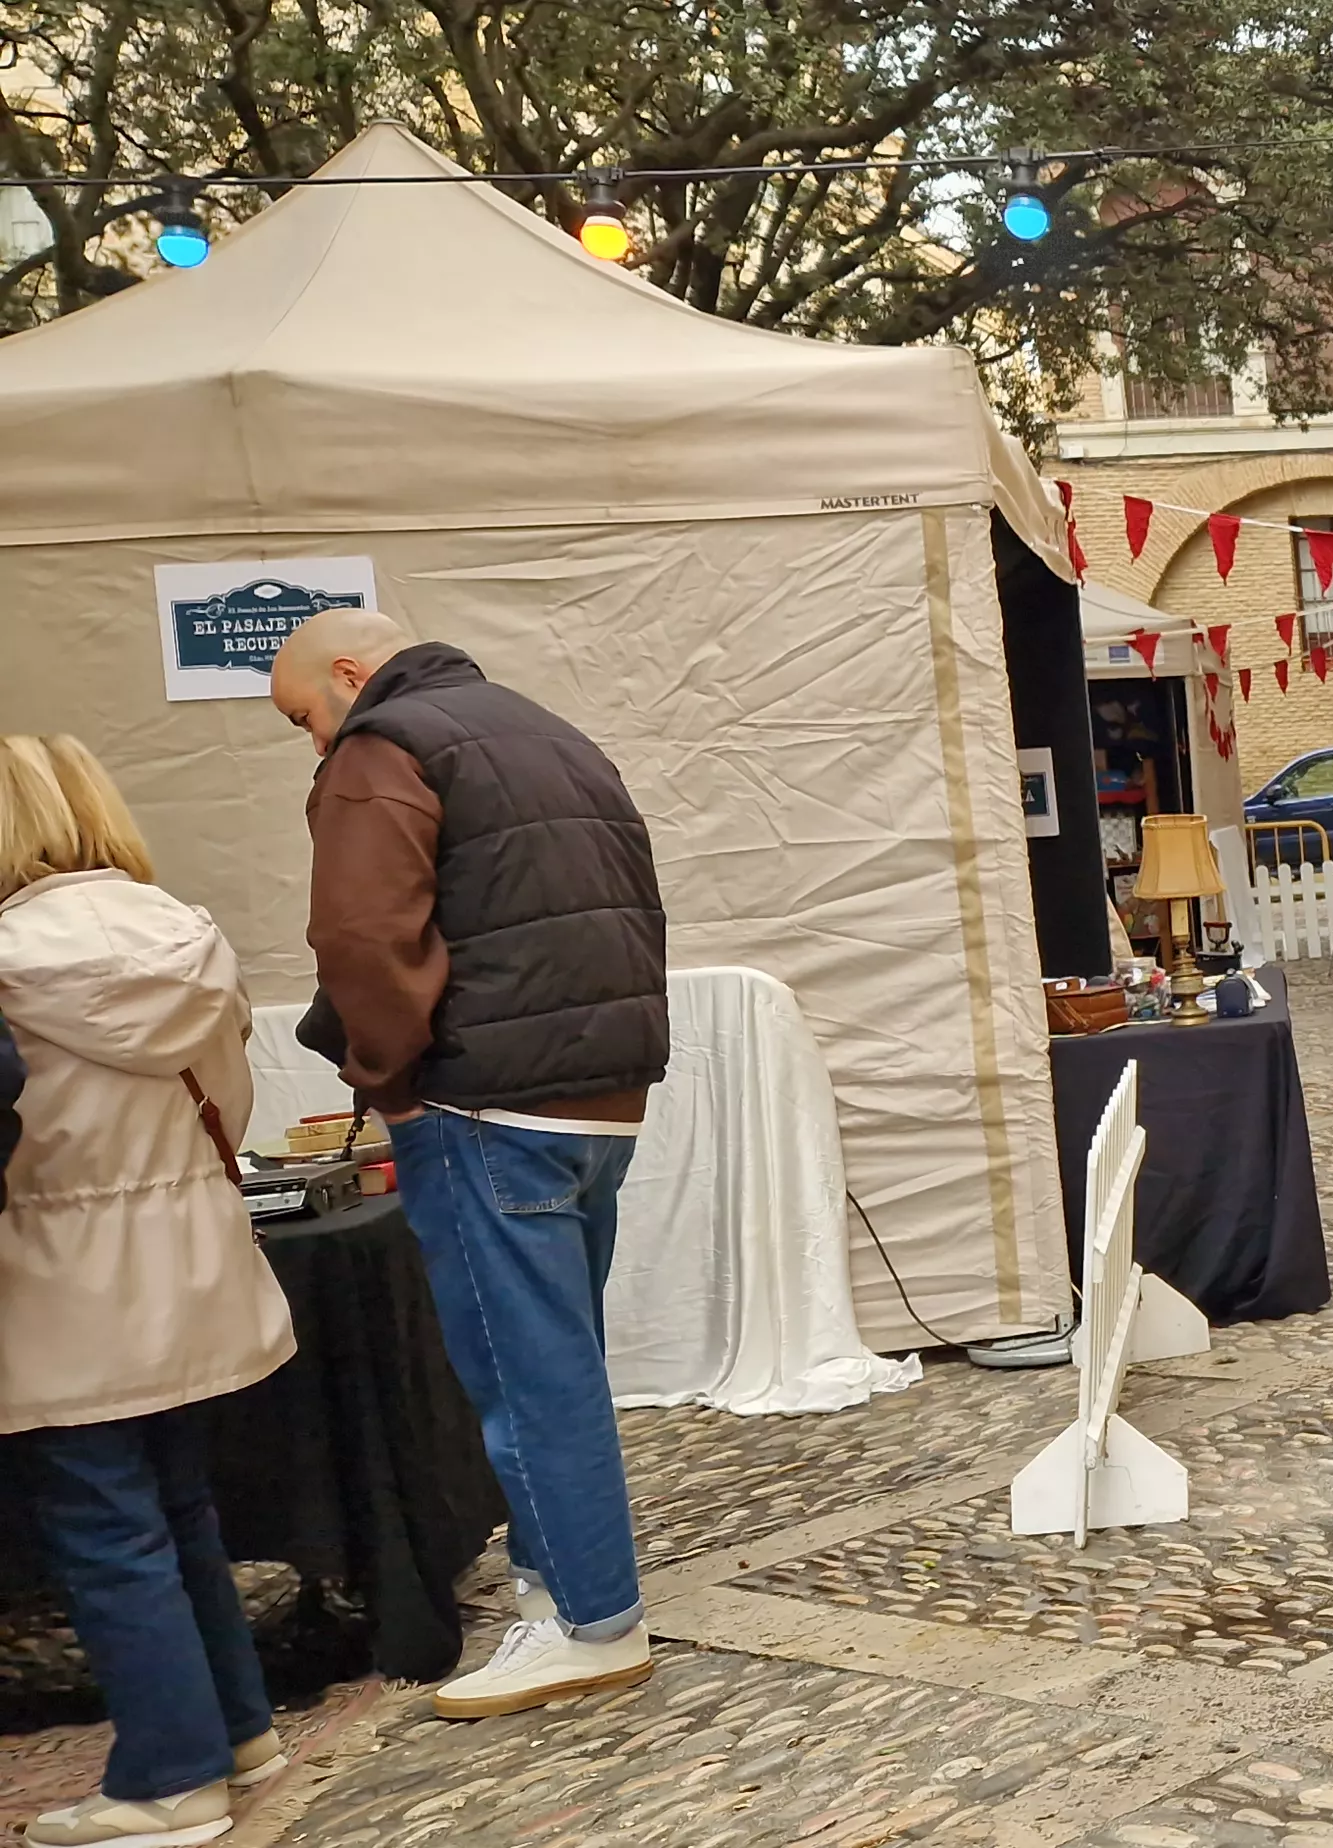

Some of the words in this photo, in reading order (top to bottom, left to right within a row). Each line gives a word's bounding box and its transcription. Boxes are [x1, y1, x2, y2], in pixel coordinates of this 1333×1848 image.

[820, 493, 920, 510] MASTERTENT
[193, 620, 217, 635] EL
[221, 617, 287, 634] PASAJE
